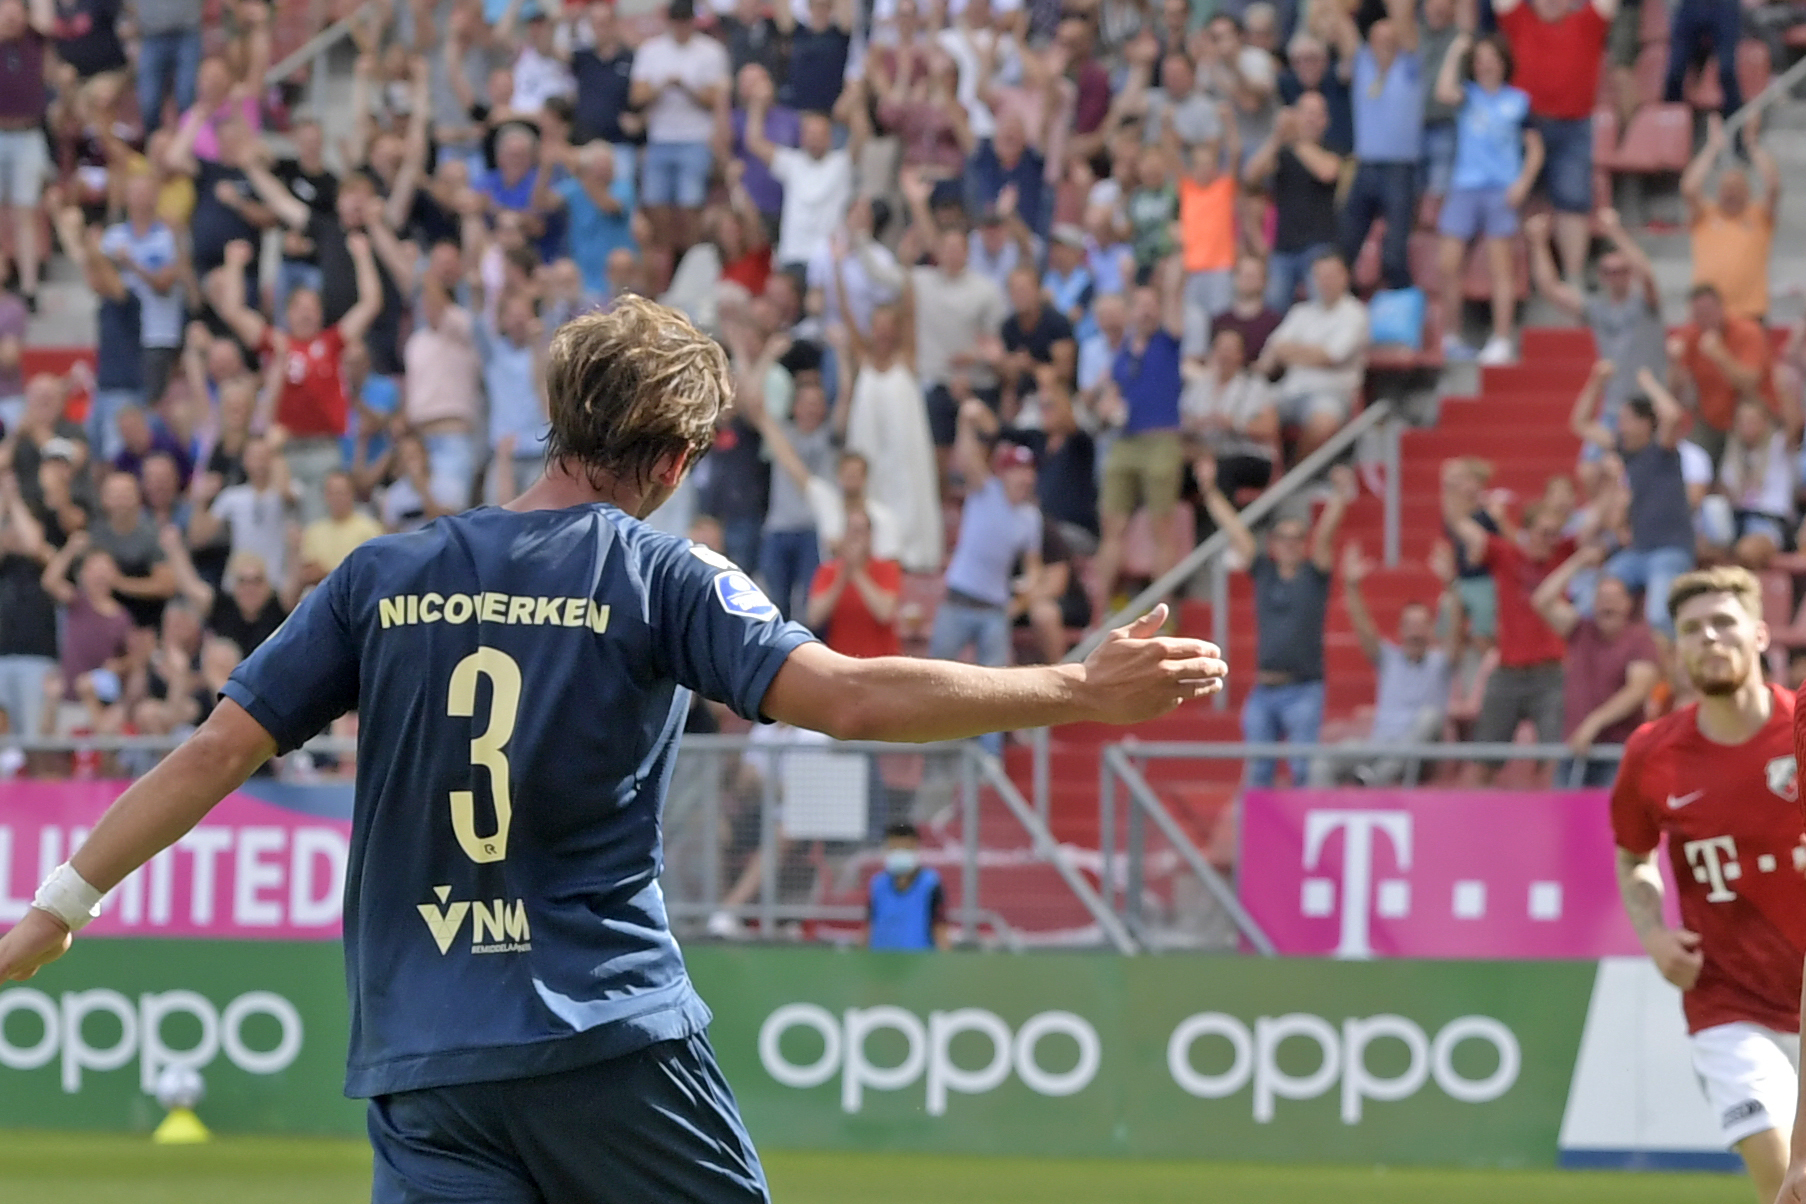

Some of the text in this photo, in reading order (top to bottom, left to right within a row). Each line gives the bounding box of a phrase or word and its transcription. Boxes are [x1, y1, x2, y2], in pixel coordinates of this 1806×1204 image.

[446, 646, 523, 864] 3
[0, 986, 302, 1095] oppo
[757, 1002, 1098, 1115] oppo
[1166, 1011, 1522, 1126] oppo
